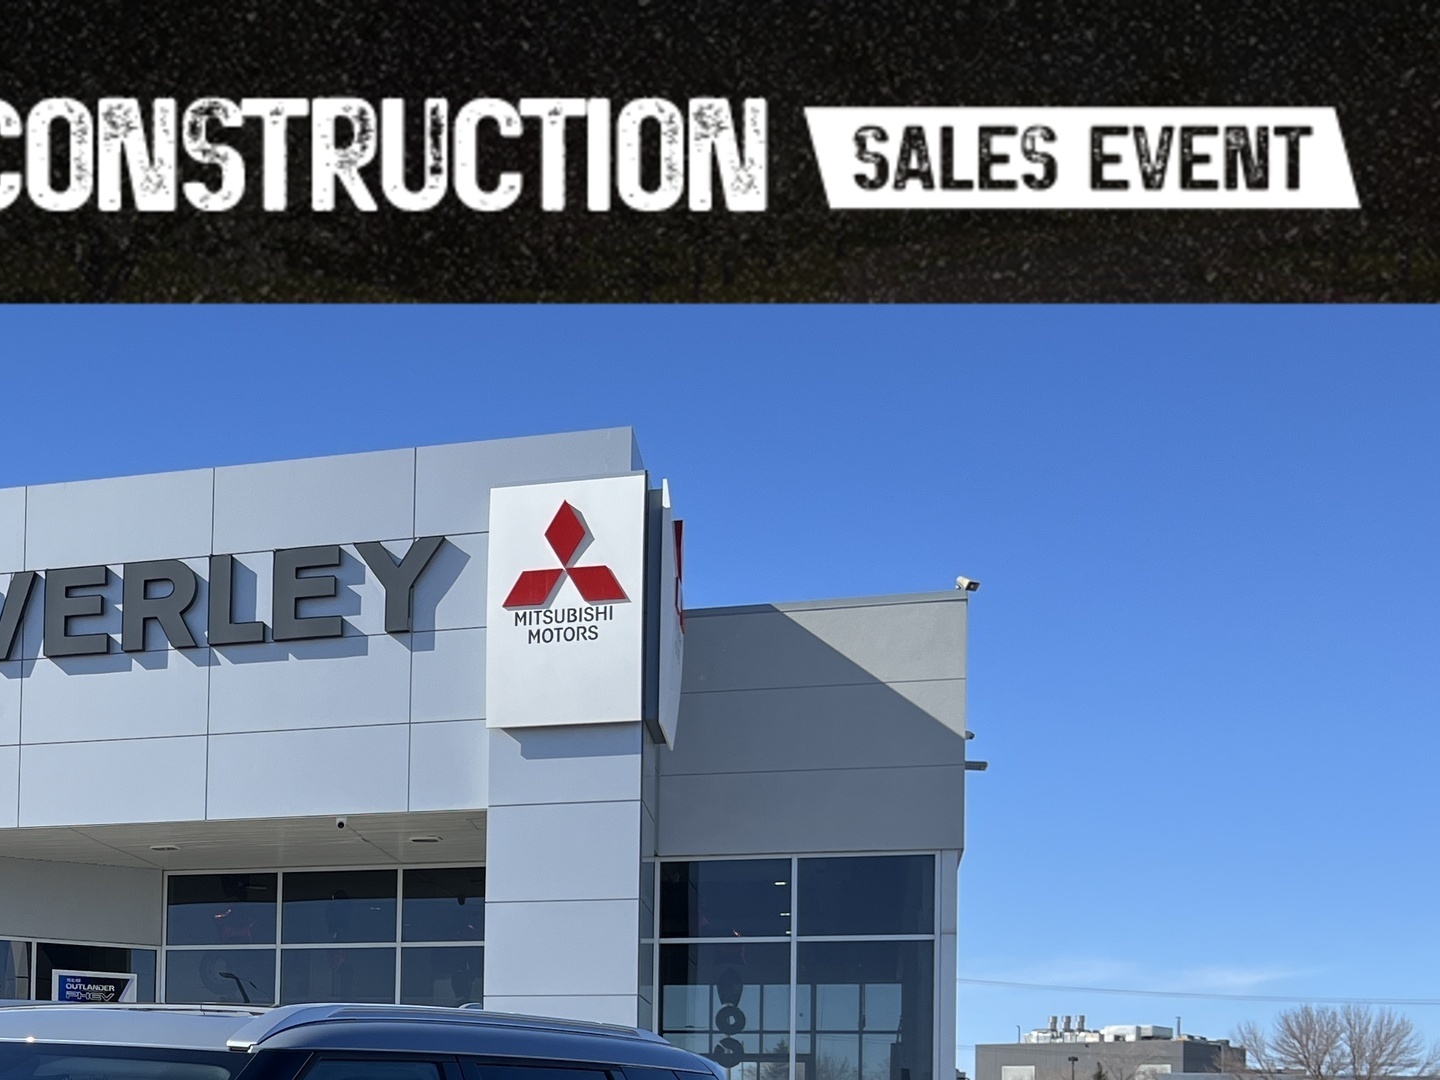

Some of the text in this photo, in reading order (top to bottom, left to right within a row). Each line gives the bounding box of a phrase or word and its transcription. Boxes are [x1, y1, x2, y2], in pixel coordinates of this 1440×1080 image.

[514, 605, 613, 627] MITSUBISHI
[528, 625, 599, 644] MOTORS
[66, 983, 115, 992] OUTLANDER
